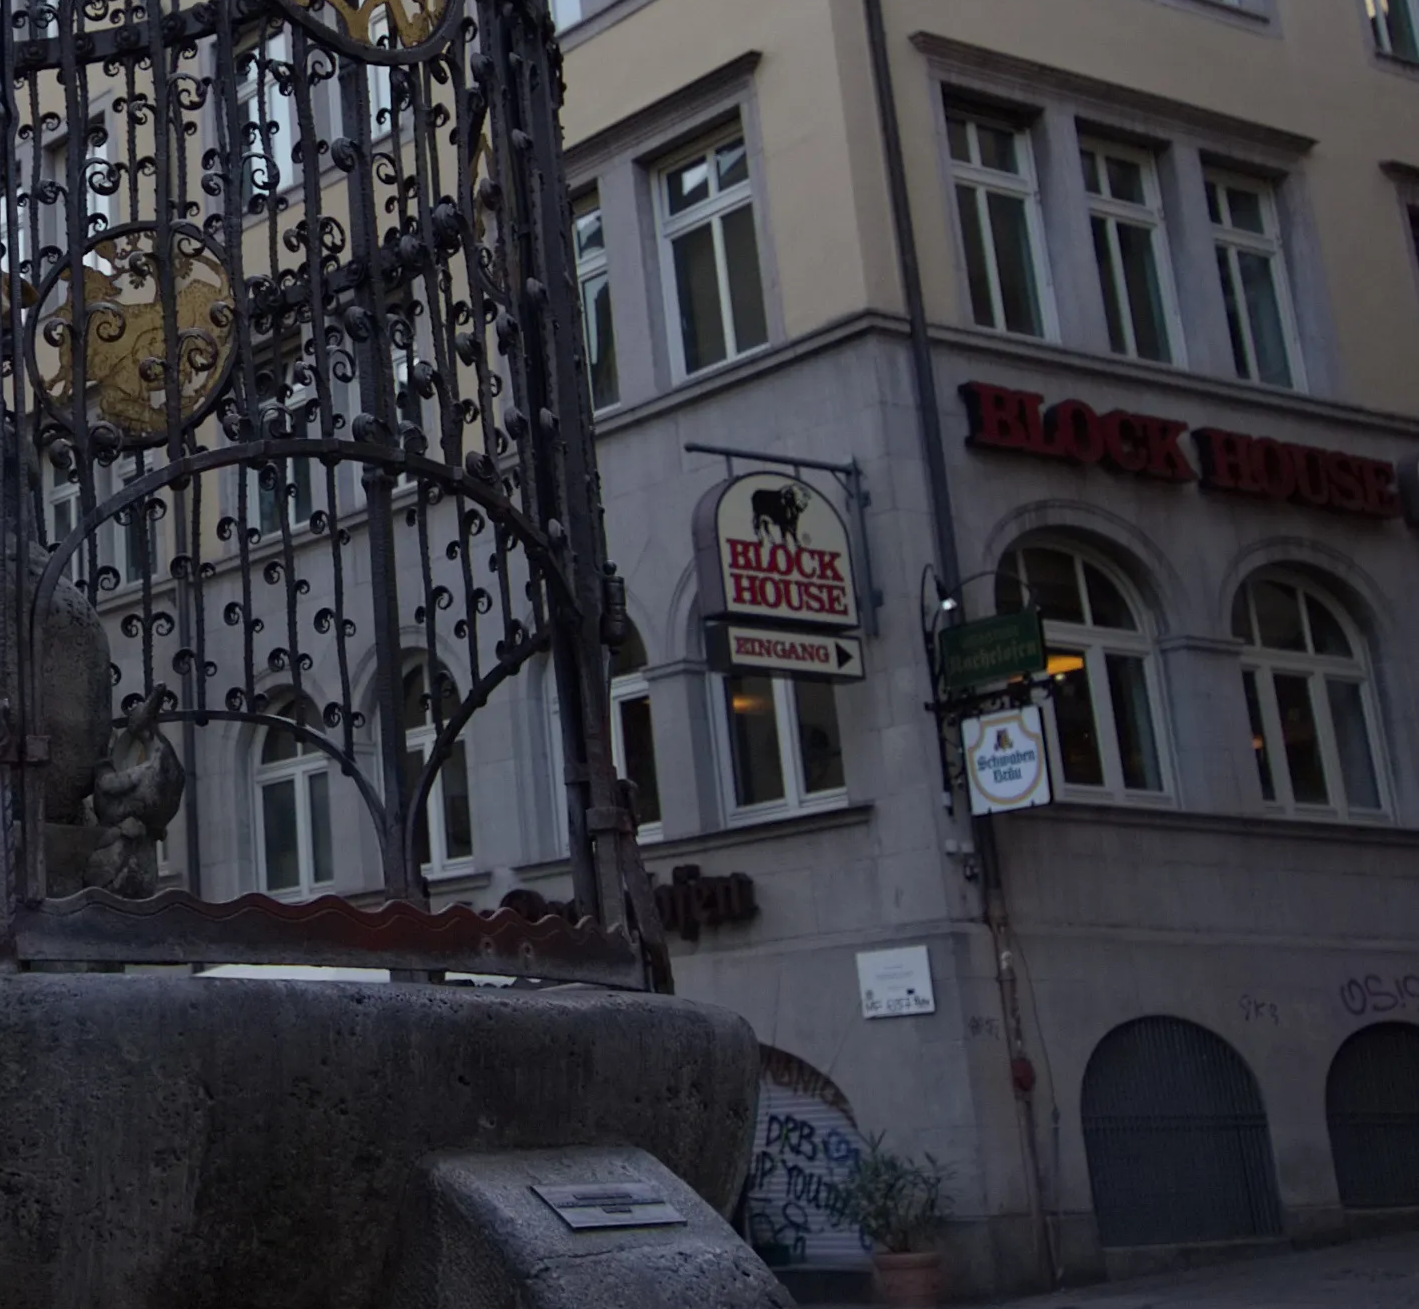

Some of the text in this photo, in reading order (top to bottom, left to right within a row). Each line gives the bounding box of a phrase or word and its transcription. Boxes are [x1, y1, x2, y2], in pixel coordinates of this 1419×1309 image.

[960, 382, 1401, 518] BLOCK HOUSE
[726, 538, 844, 582] BLOCK
[730, 573, 848, 616] HOUSE
[734, 636, 830, 663] EINGANG
[977, 748, 1036, 771] Schwaben
